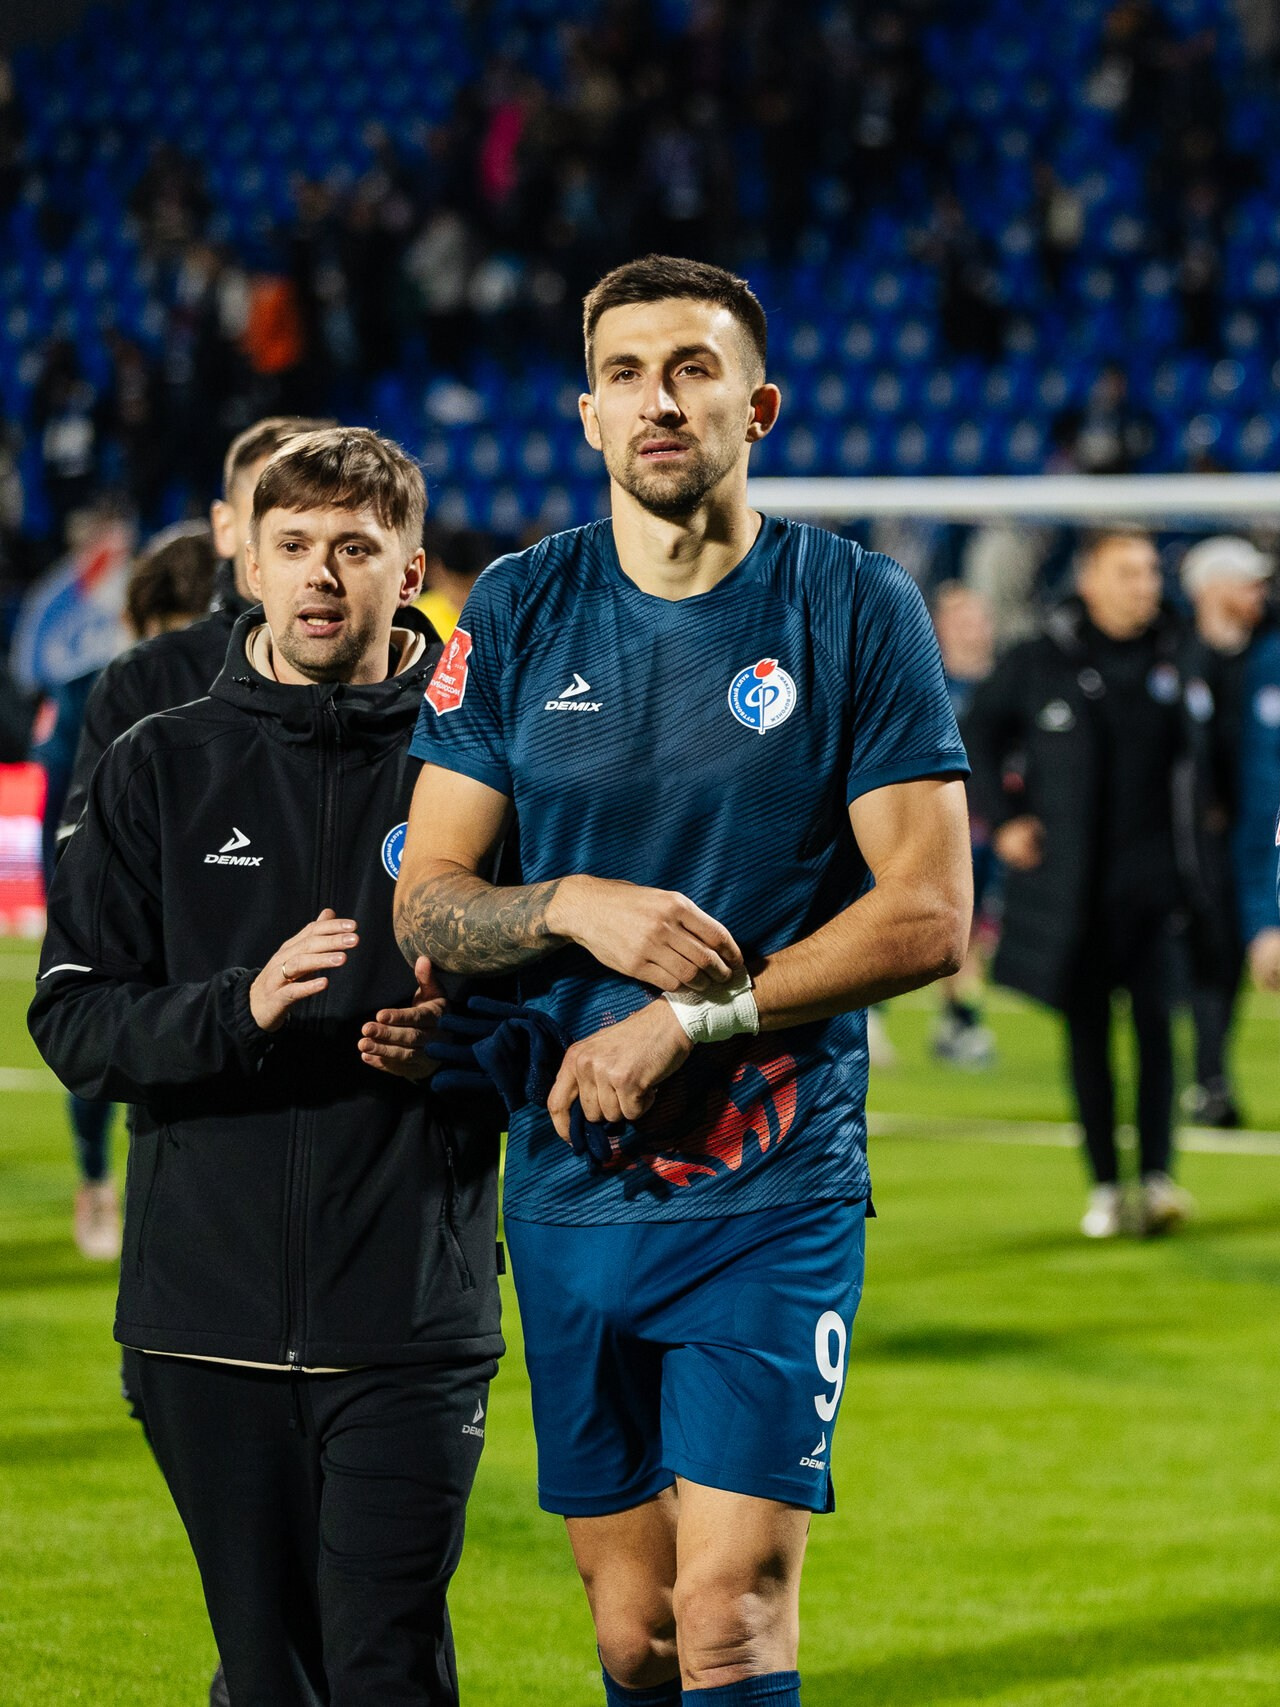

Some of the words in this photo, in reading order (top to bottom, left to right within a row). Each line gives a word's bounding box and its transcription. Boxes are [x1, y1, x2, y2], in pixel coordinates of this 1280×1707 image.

[736, 673, 750, 688] КЛУБ
[544, 700, 604, 712] DEMIX
[771, 698, 791, 722] ВОРОНЕЖ
[203, 854, 264, 867] DEMIX
[387, 843, 399, 875] ТБОЛЬНЫЙ
[814, 1310, 847, 1422] 9
